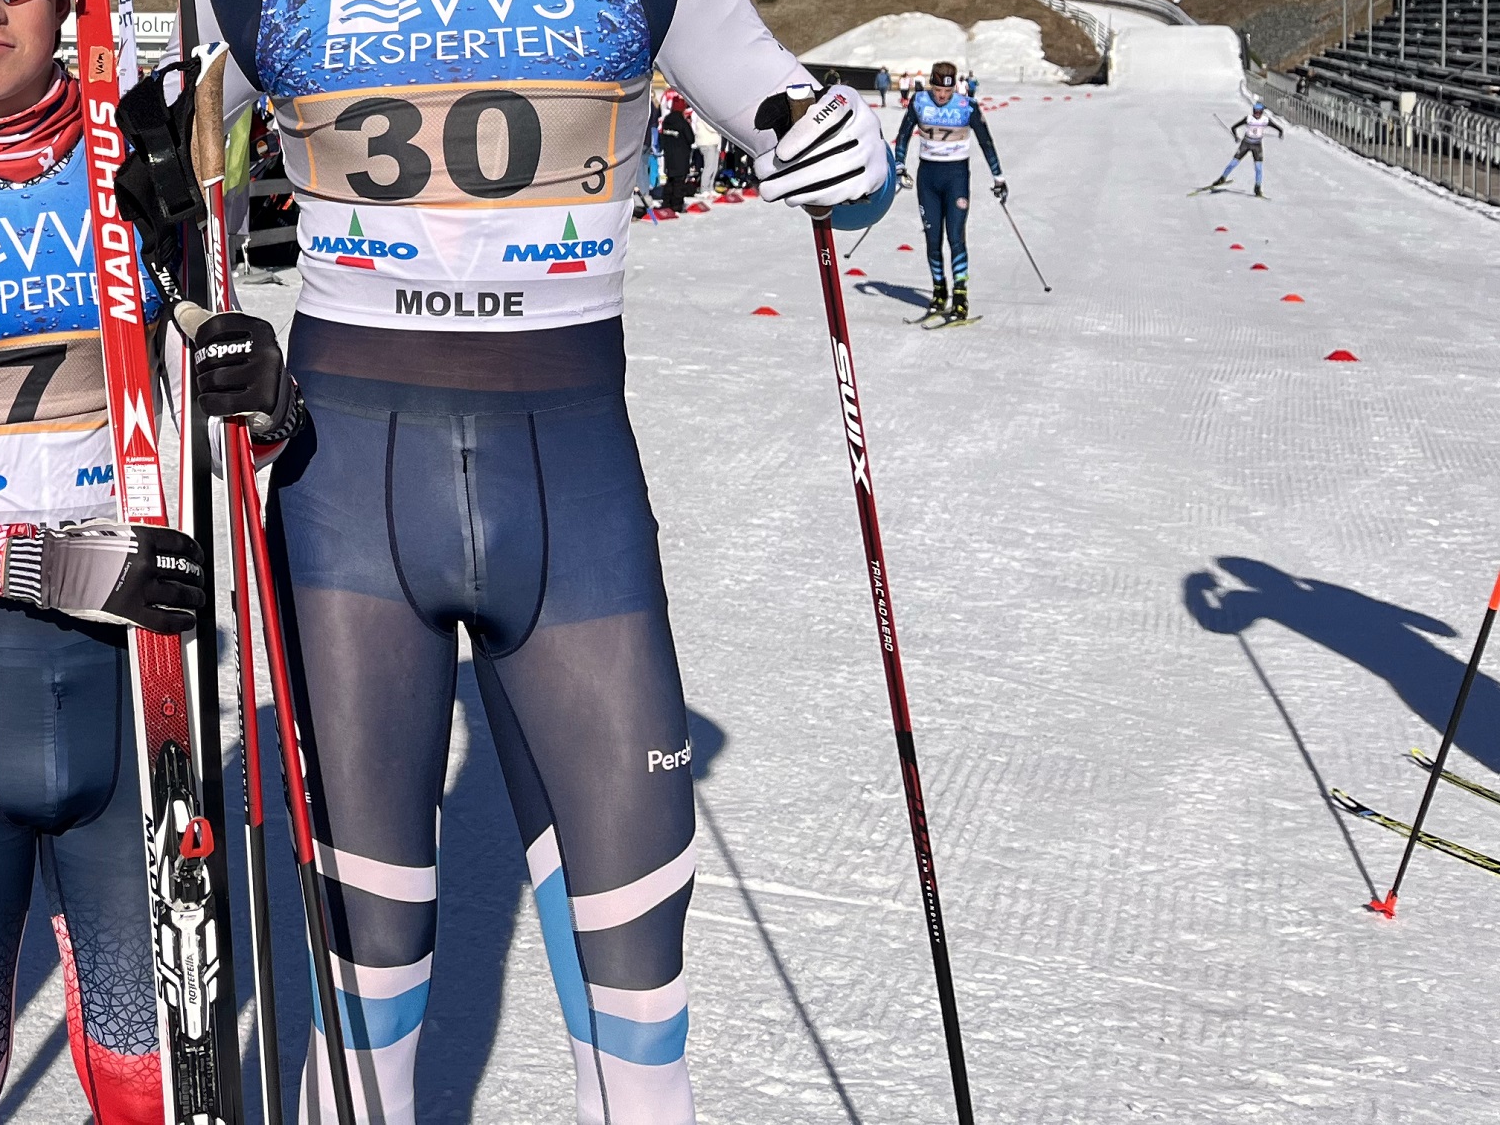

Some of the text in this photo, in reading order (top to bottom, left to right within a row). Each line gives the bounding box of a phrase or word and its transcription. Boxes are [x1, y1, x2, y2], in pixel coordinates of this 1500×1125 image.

[324, 26, 585, 69] EKSPERTEN
[334, 89, 542, 201] 30
[581, 156, 608, 195] 3
[89, 97, 138, 324] MADSHUS
[0, 209, 93, 272] VV
[308, 236, 418, 260] MAXBO
[502, 237, 614, 263] MAXBO
[821, 247, 832, 267] TCS
[395, 289, 525, 317] MOLDE
[871, 560, 885, 598] TRIAC
[880, 616, 893, 653] AERO
